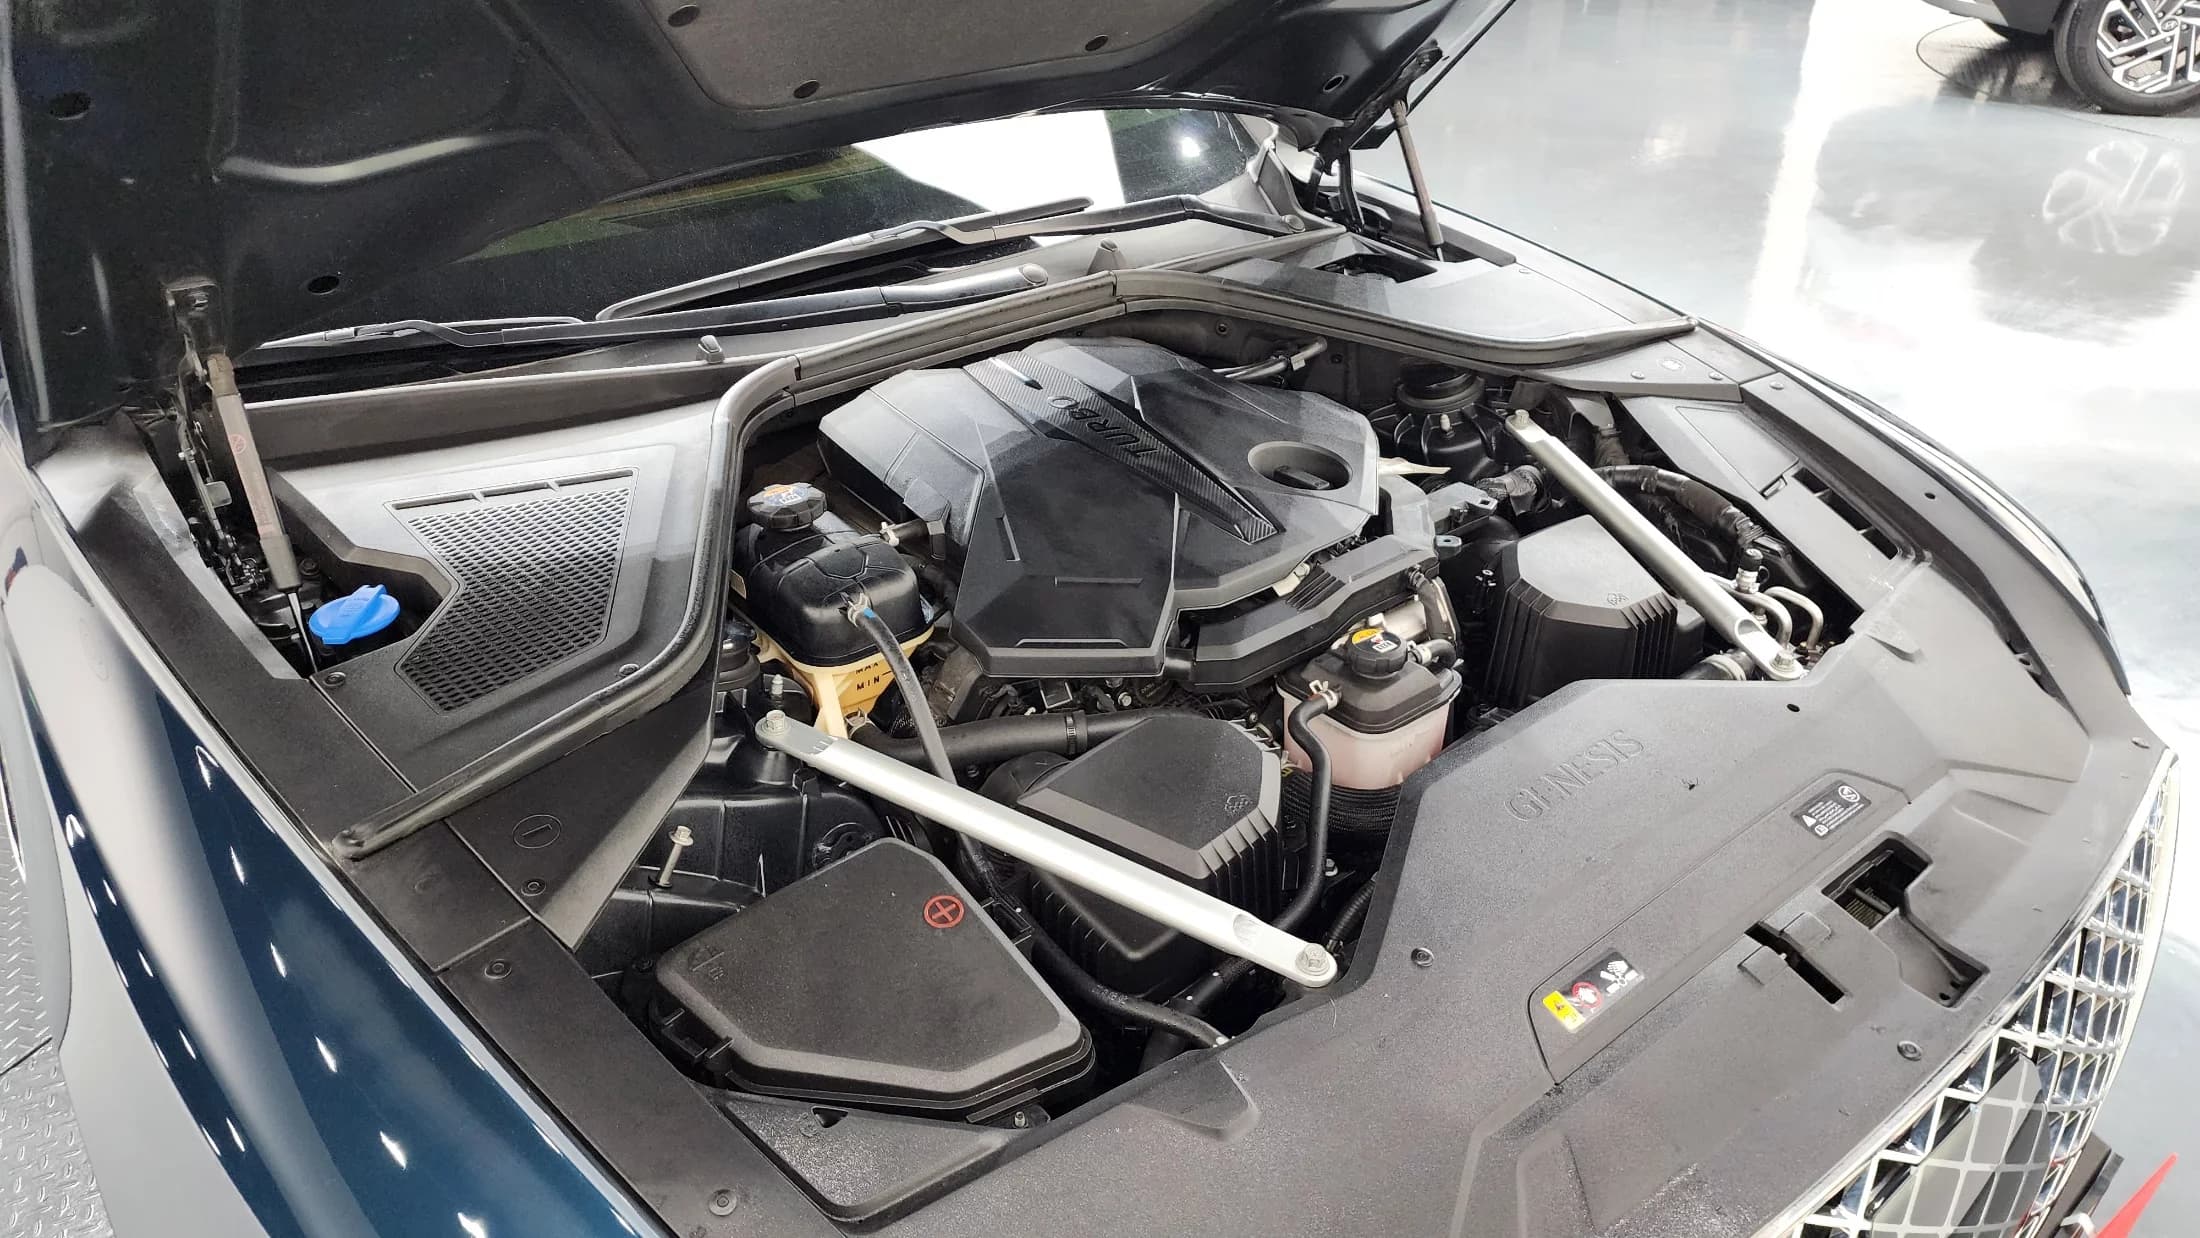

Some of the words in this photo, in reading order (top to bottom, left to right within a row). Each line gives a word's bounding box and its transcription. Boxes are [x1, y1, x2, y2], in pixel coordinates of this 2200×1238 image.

[1048, 397, 1158, 458] TURBO
[856, 675, 880, 692] MIN
[1503, 729, 1645, 822] GENESIS
